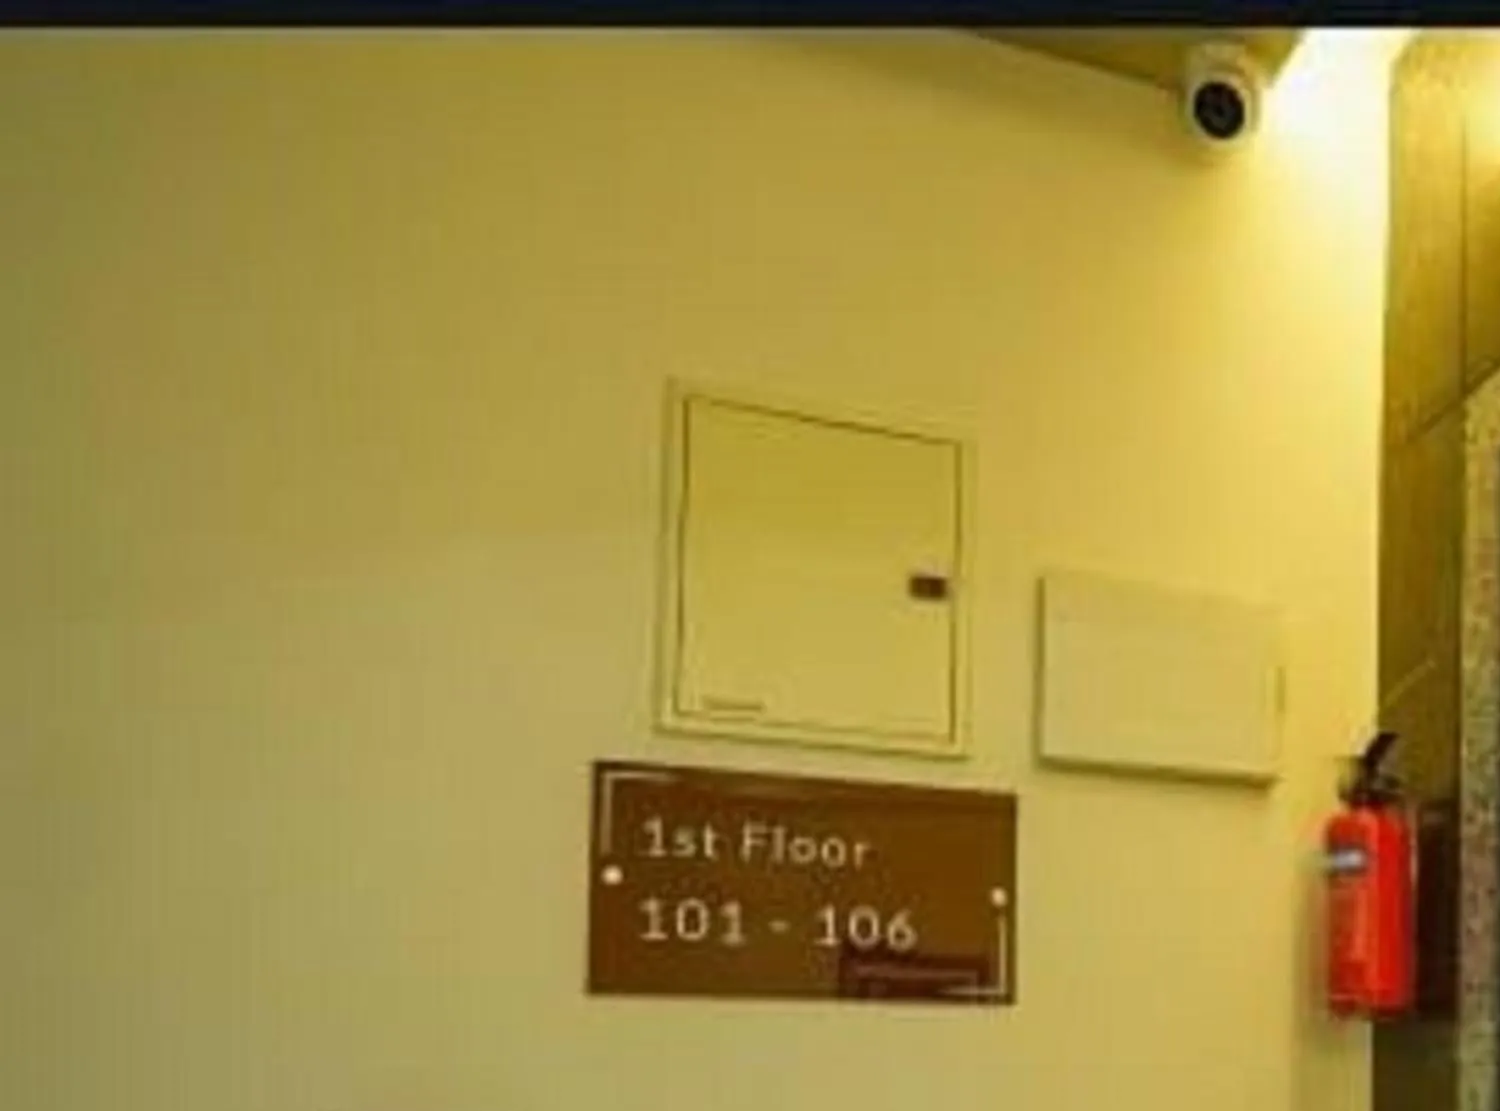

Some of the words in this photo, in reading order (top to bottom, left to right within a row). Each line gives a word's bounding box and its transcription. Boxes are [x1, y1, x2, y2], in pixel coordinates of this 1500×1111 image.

[642, 816, 720, 859] 1st
[740, 821, 872, 868] Floor
[639, 897, 747, 945] 101
[813, 904, 918, 951] 106
